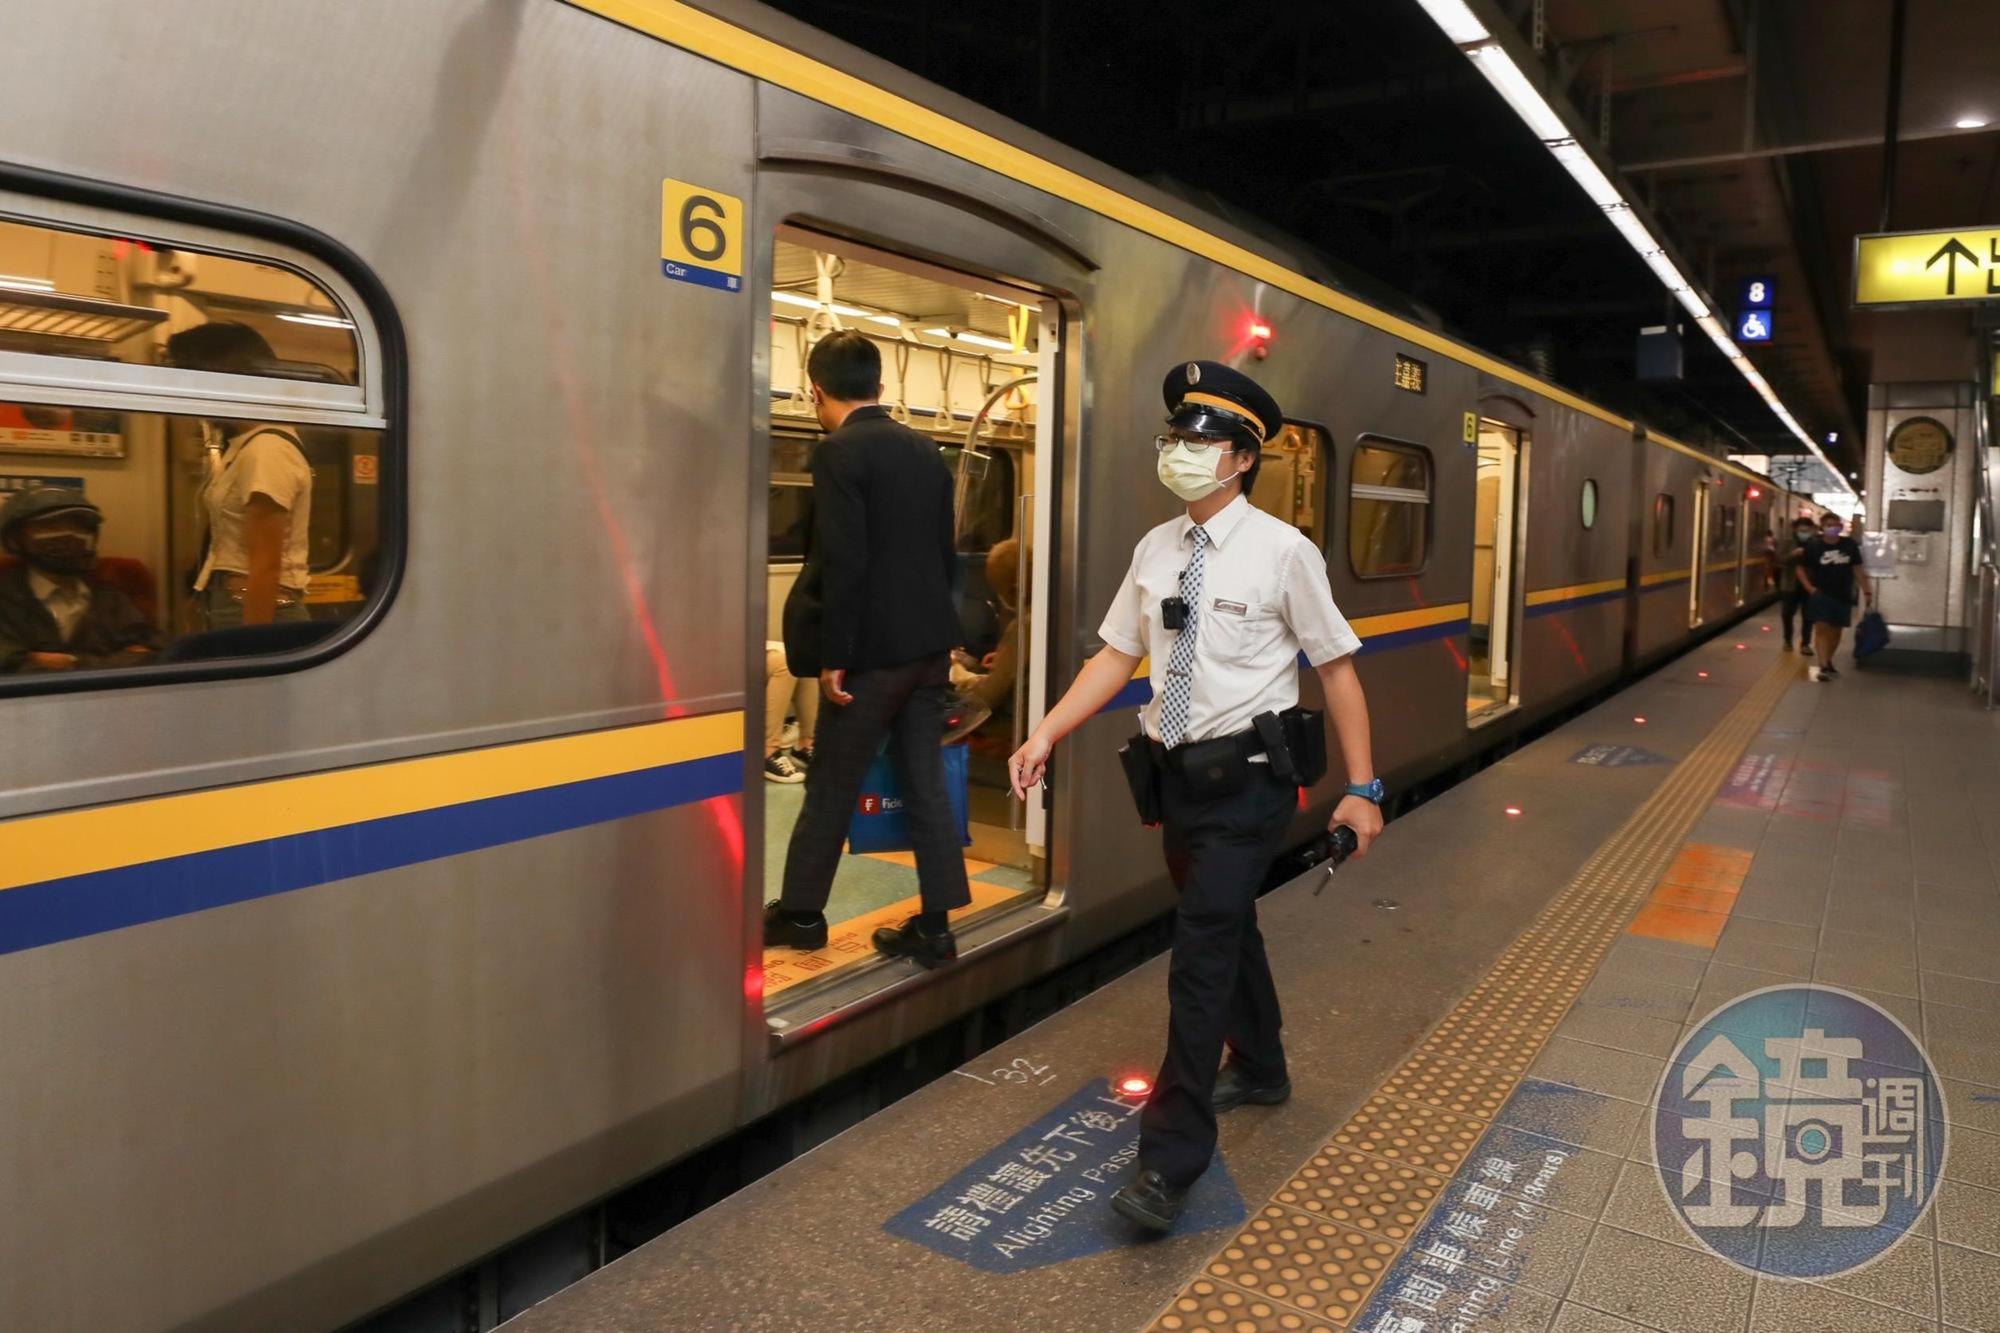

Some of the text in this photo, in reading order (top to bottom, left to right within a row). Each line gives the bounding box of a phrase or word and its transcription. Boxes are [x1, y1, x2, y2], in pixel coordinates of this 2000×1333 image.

[680, 195, 726, 261] 6
[666, 263, 687, 276] Car
[1749, 282, 1765, 302] 8
[993, 1135, 1140, 1259] Alighting Passe
[1451, 1277, 1499, 1333] aiting
[1484, 1227, 1524, 1270] Line
